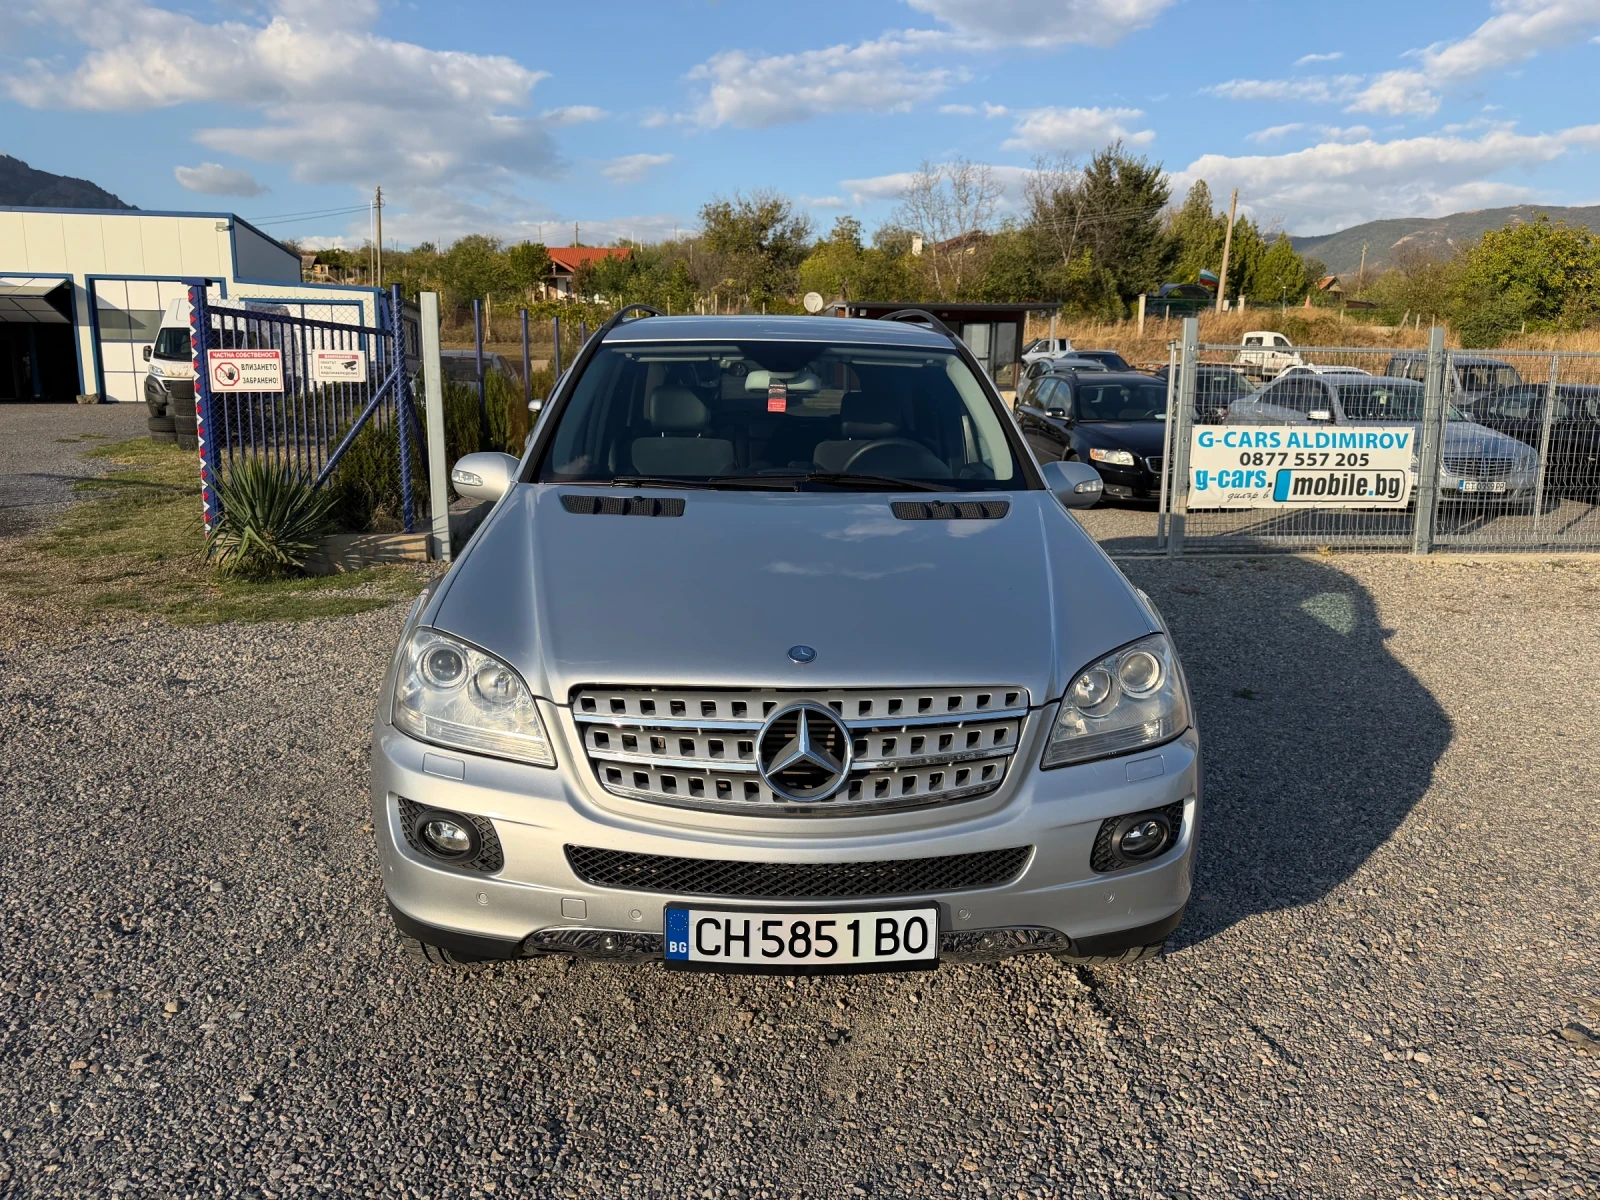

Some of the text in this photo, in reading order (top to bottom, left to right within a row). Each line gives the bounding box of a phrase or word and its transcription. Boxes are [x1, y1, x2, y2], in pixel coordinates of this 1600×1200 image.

[241, 363, 278, 371] ВЛИЗАНЕТО
[1198, 431, 1409, 449] G-CARS ALDIMIROV
[1239, 452, 1369, 467] 0877 557 205
[1292, 473, 1400, 498] mobile.bg
[669, 941, 687, 954] BG
